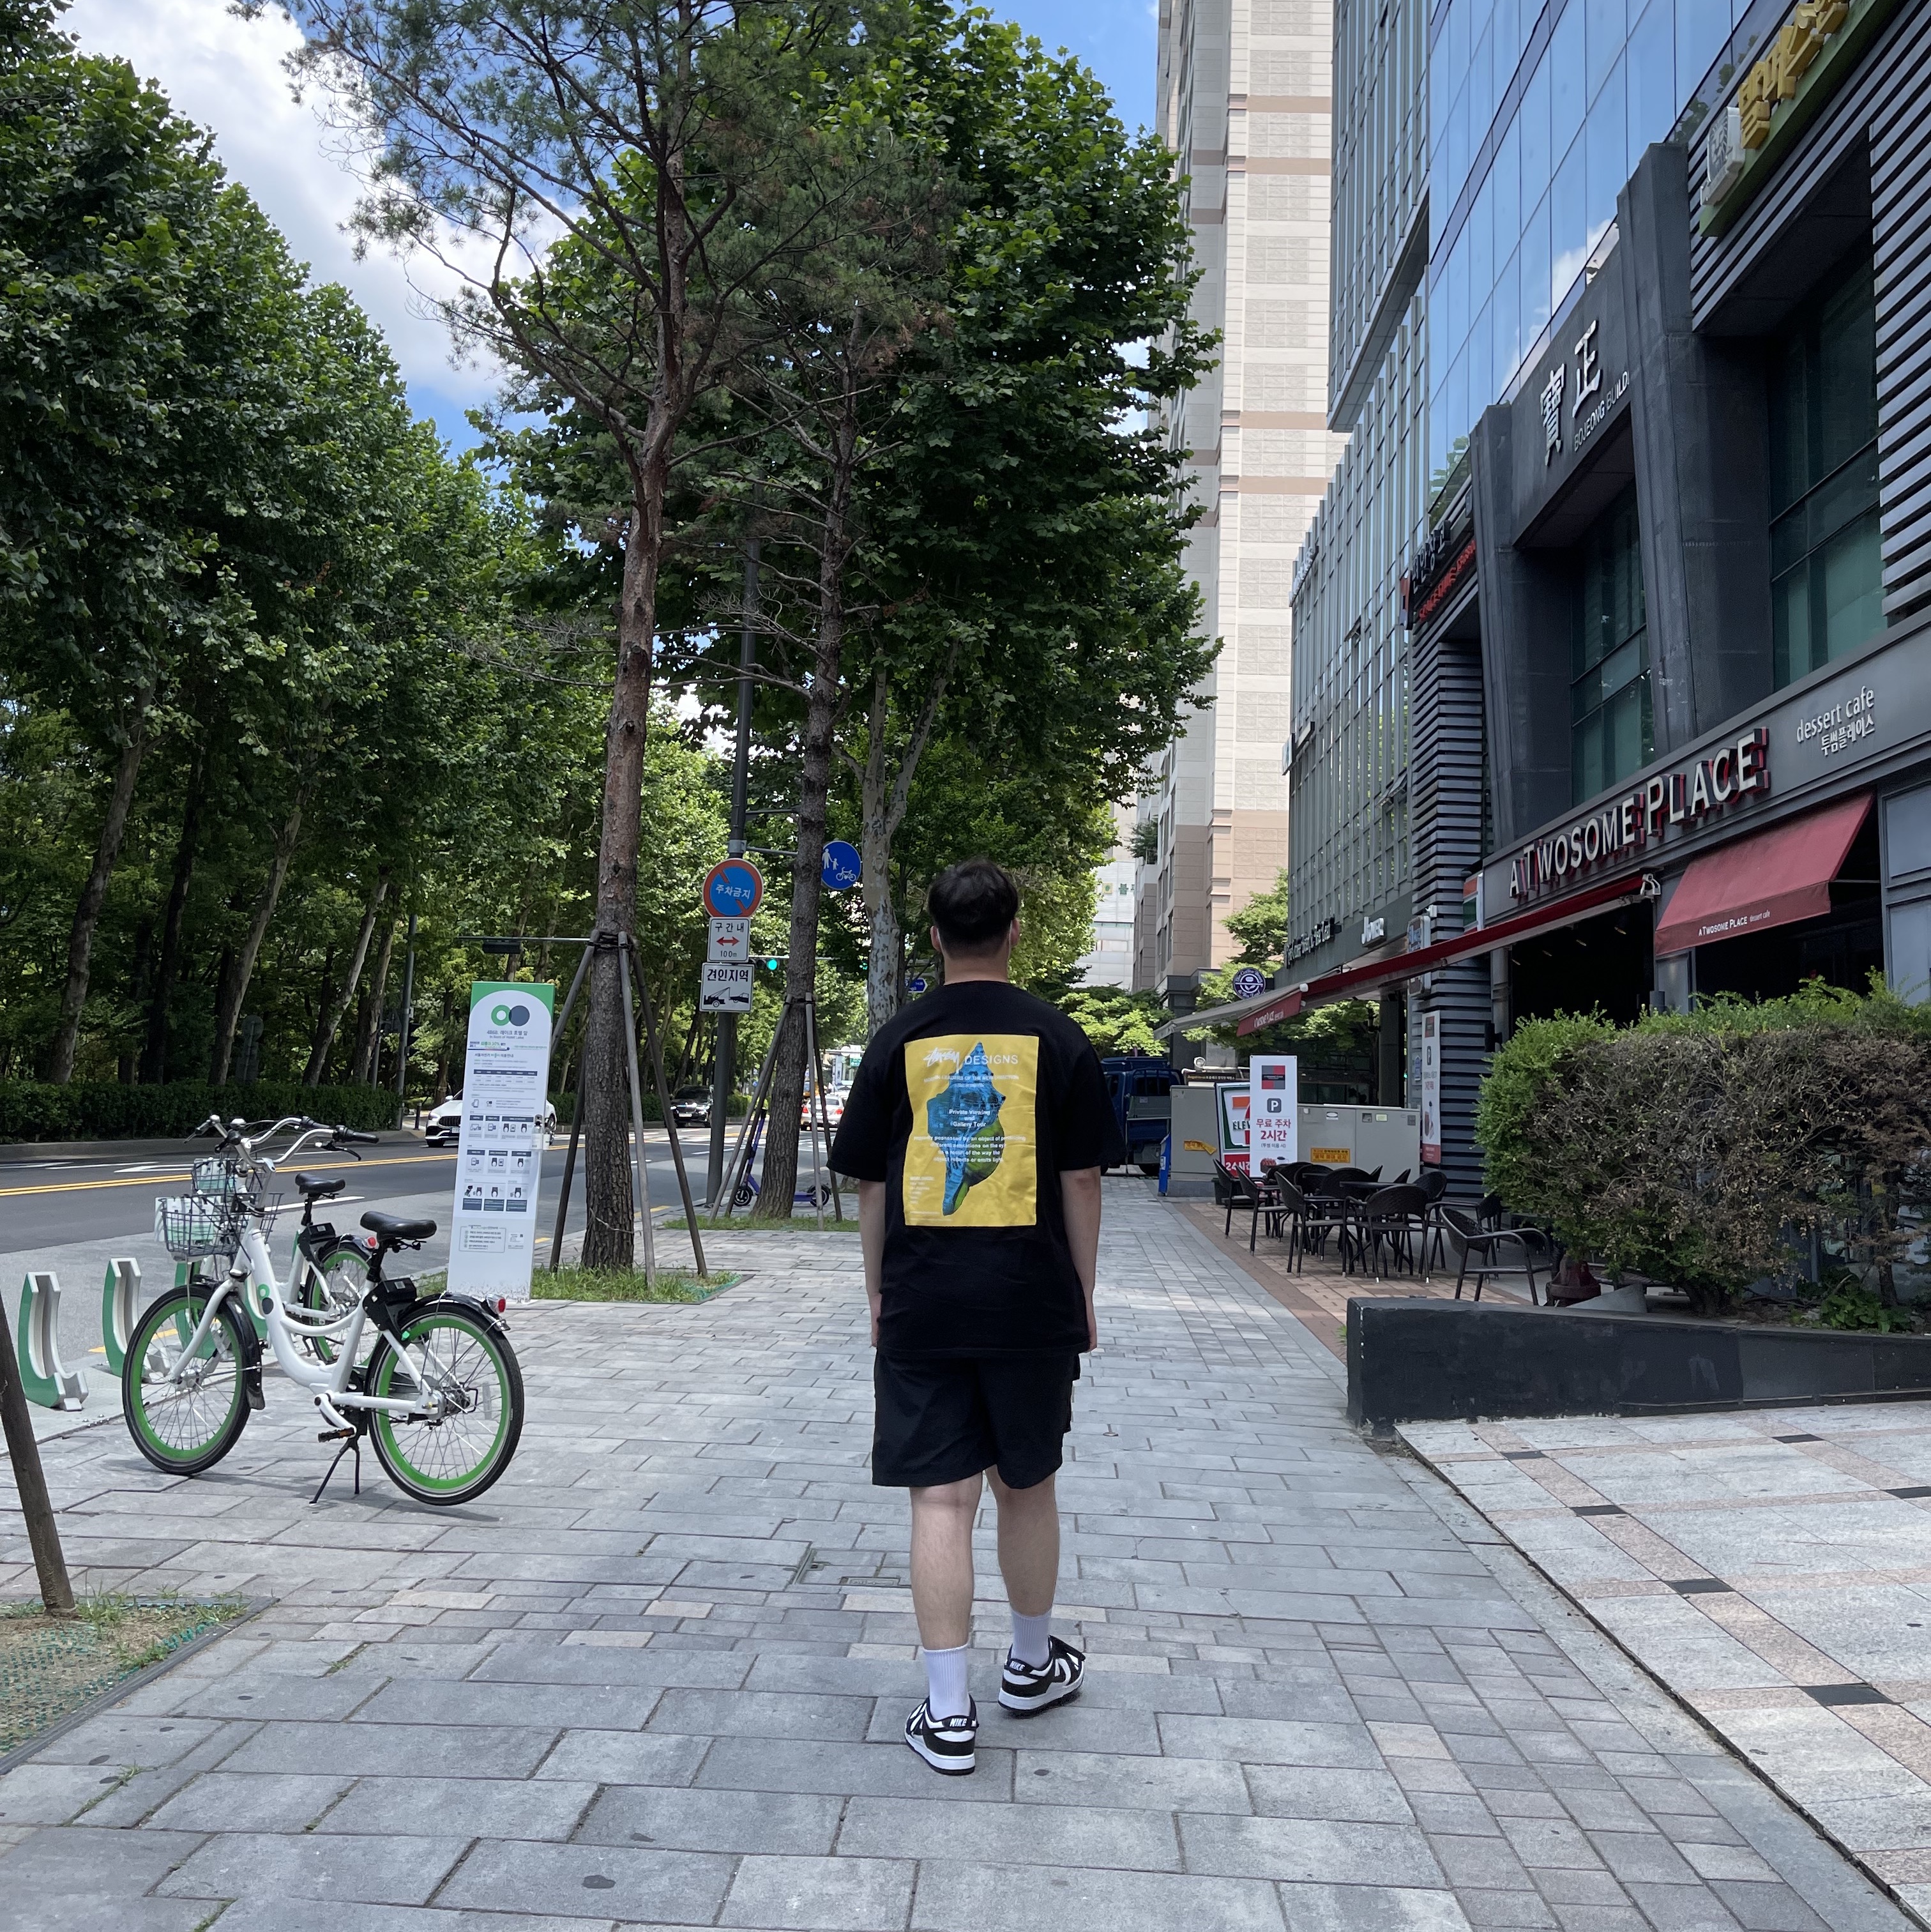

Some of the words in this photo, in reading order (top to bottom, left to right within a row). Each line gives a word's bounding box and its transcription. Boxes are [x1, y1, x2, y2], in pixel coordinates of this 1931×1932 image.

[1574, 400, 1605, 452] BOJEONG
[1797, 703, 1842, 742] dessert
[1846, 685, 1874, 718] cafe
[1821, 713, 1875, 756] 투썸플레이스
[1509, 858, 1521, 898] A
[1523, 795, 1644, 890] TWOSOME
[1646, 728, 1768, 836] PLACE
[715, 883, 751, 899] 주차금지
[1702, 922, 1729, 935] TWOSOME
[1729, 916, 1748, 929] PLACE
[707, 968, 749, 982] 견인지역
[964, 1054, 1019, 1065] DESIGNS
[1271, 1100, 1279, 1111] P
[1256, 1118, 1273, 1128] 무료
[1275, 1118, 1291, 1129] 주차
[1261, 1129, 1287, 1142] 2시간
[1009, 1661, 1026, 1671] NIKE
[950, 1718, 967, 1727] NIKE
